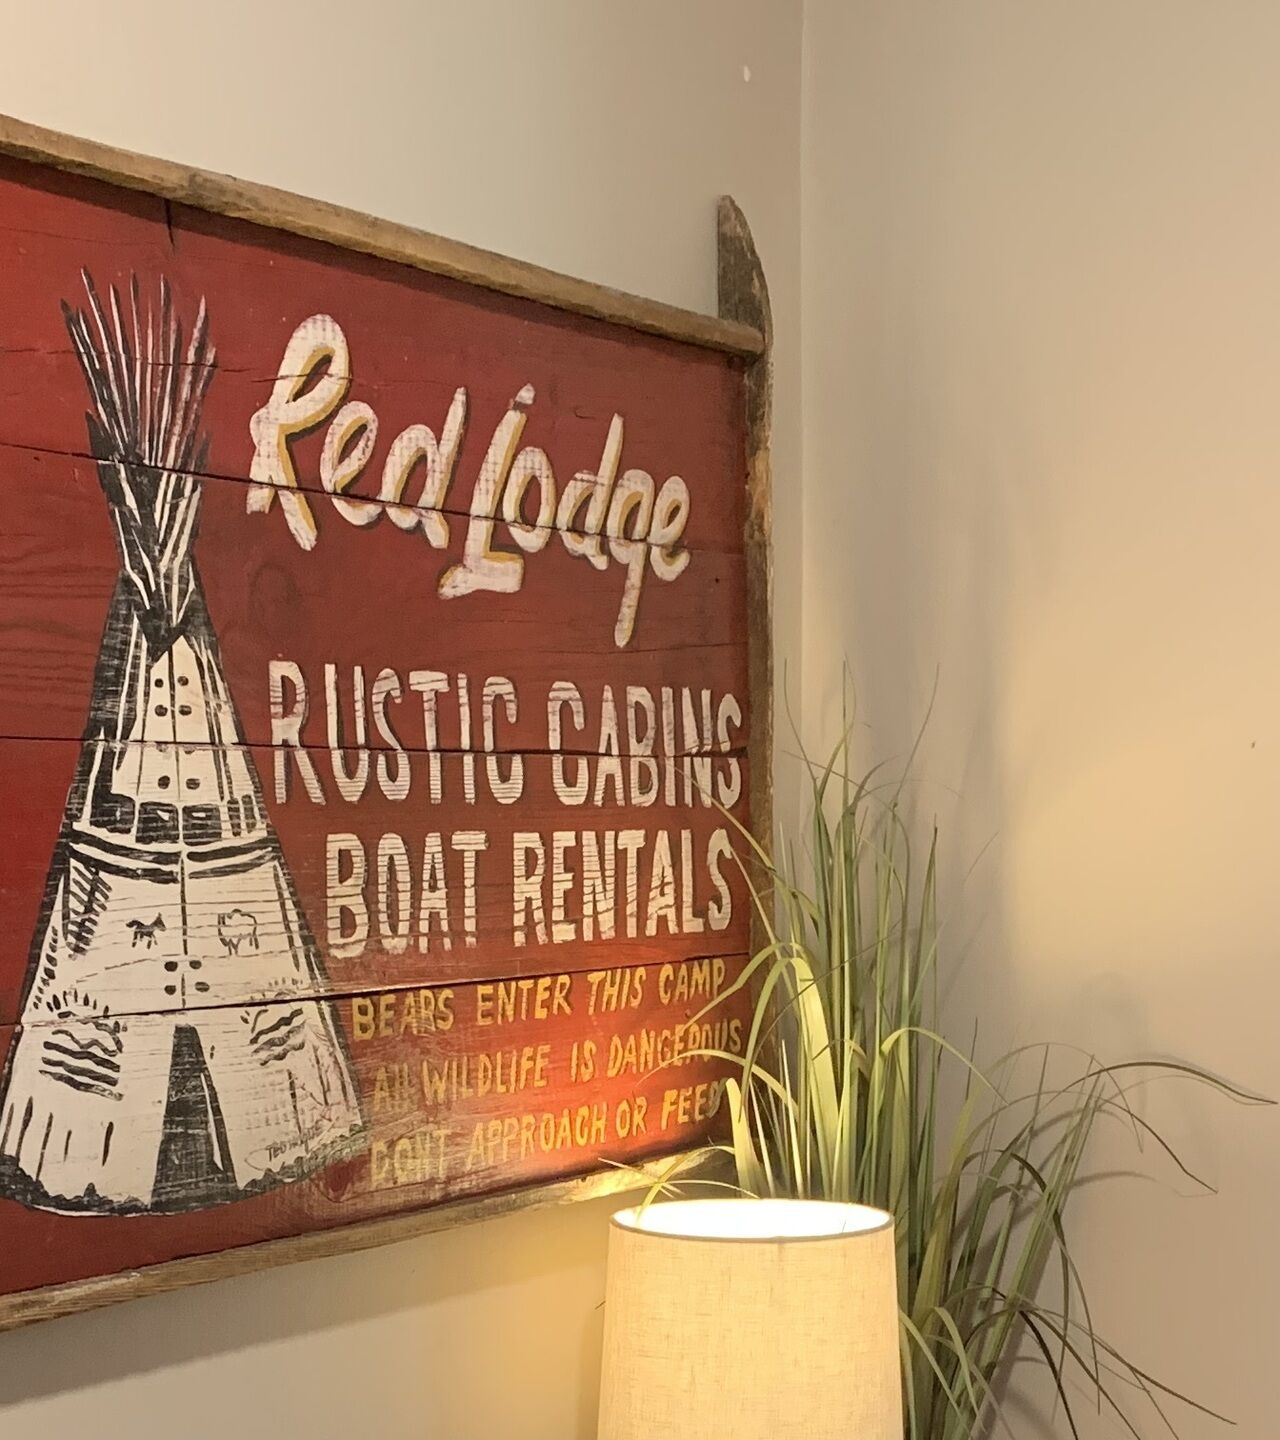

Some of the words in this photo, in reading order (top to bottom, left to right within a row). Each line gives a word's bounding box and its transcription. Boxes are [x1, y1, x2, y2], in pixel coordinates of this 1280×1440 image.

[246, 313, 467, 551] Red
[438, 383, 690, 648] Lodge
[268, 660, 524, 806] RUSTIC
[547, 680, 742, 809] CABINS
[325, 830, 489, 958] BOAT
[513, 827, 733, 948] RENTALS
[352, 988, 455, 1041] BEARS
[477, 973, 573, 1027] ENTER
[587, 967, 647, 1016] THIS
[658, 957, 726, 1006] CAMP
[422, 1043, 552, 1106] WILDLIFE
[570, 1040, 597, 1084] IS
[606, 1018, 743, 1079] DANGEROUS
[466, 1102, 608, 1172] APPROACH
[615, 1096, 648, 1138] OR
[660, 1077, 730, 1131] FEED
